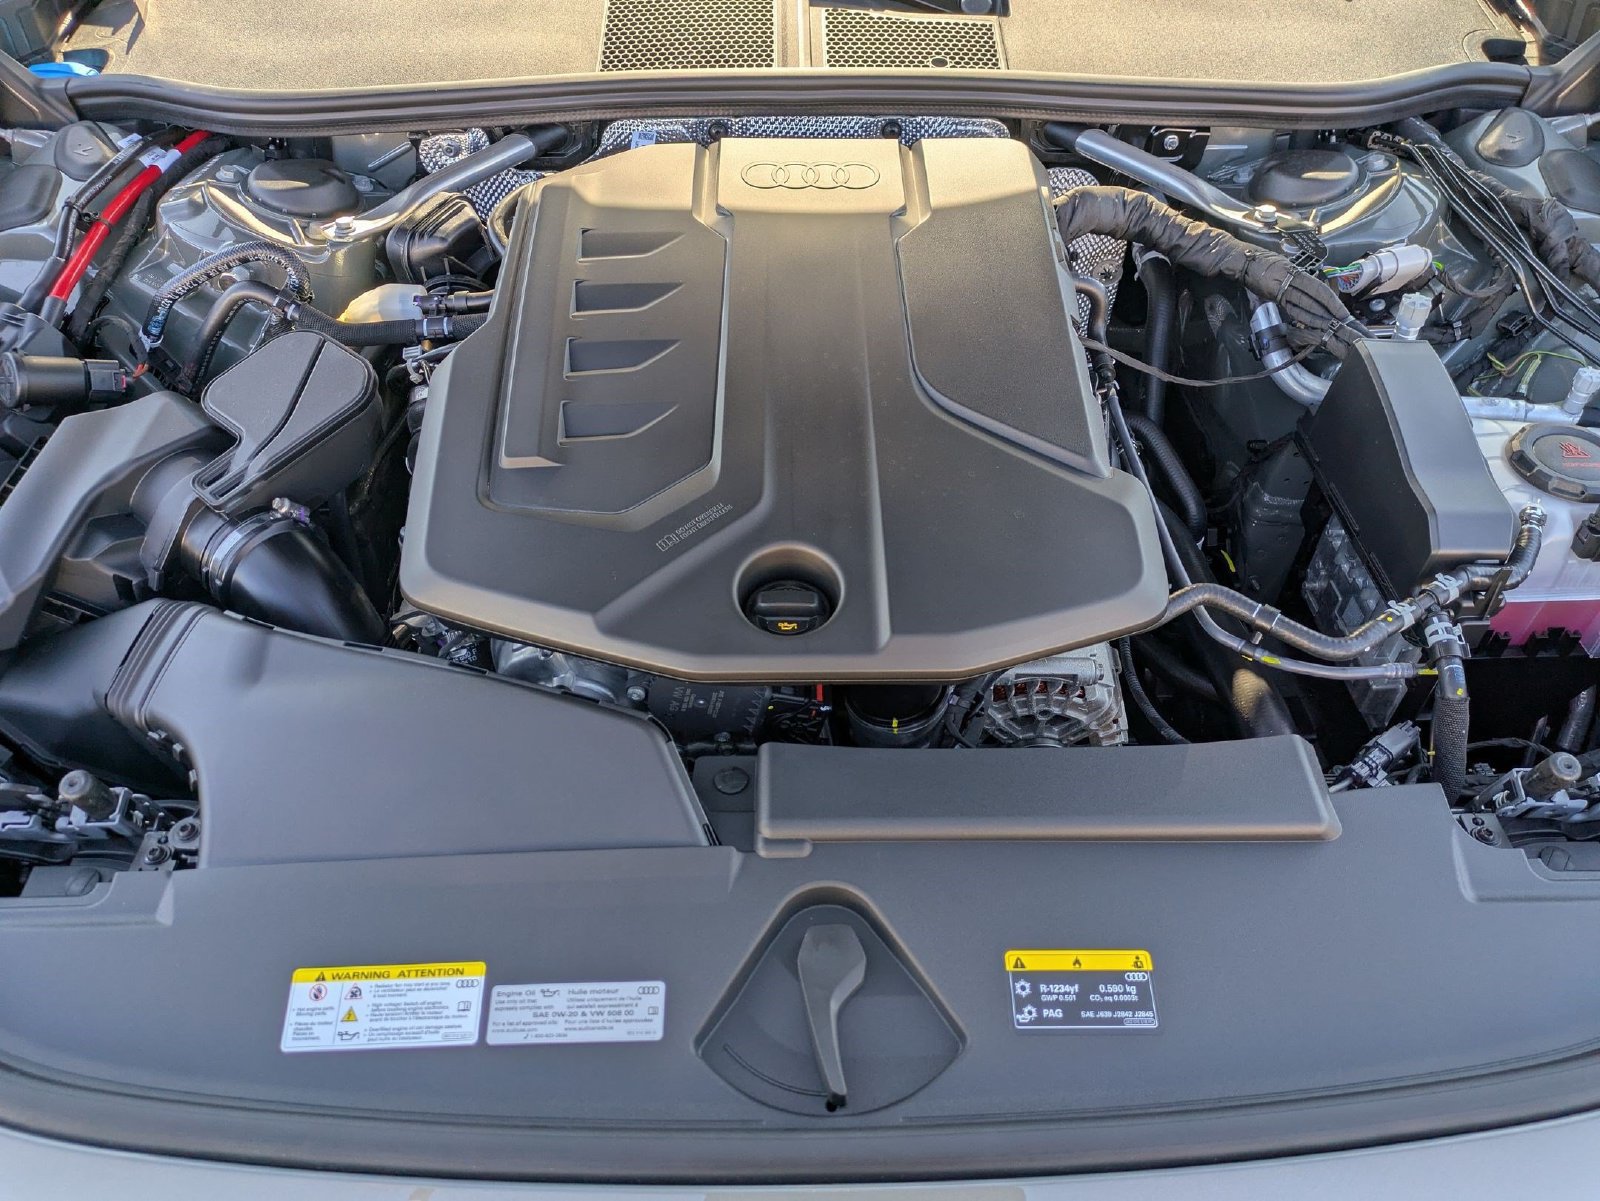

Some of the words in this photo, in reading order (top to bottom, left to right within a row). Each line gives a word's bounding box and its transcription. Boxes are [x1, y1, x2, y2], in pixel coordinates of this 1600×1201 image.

[332, 971, 390, 980] WARNING
[398, 968, 464, 978] ATTENTION
[1040, 984, 1079, 994] R-1234yf
[1126, 984, 1136, 994] kg
[1042, 1008, 1064, 1018] PAG
